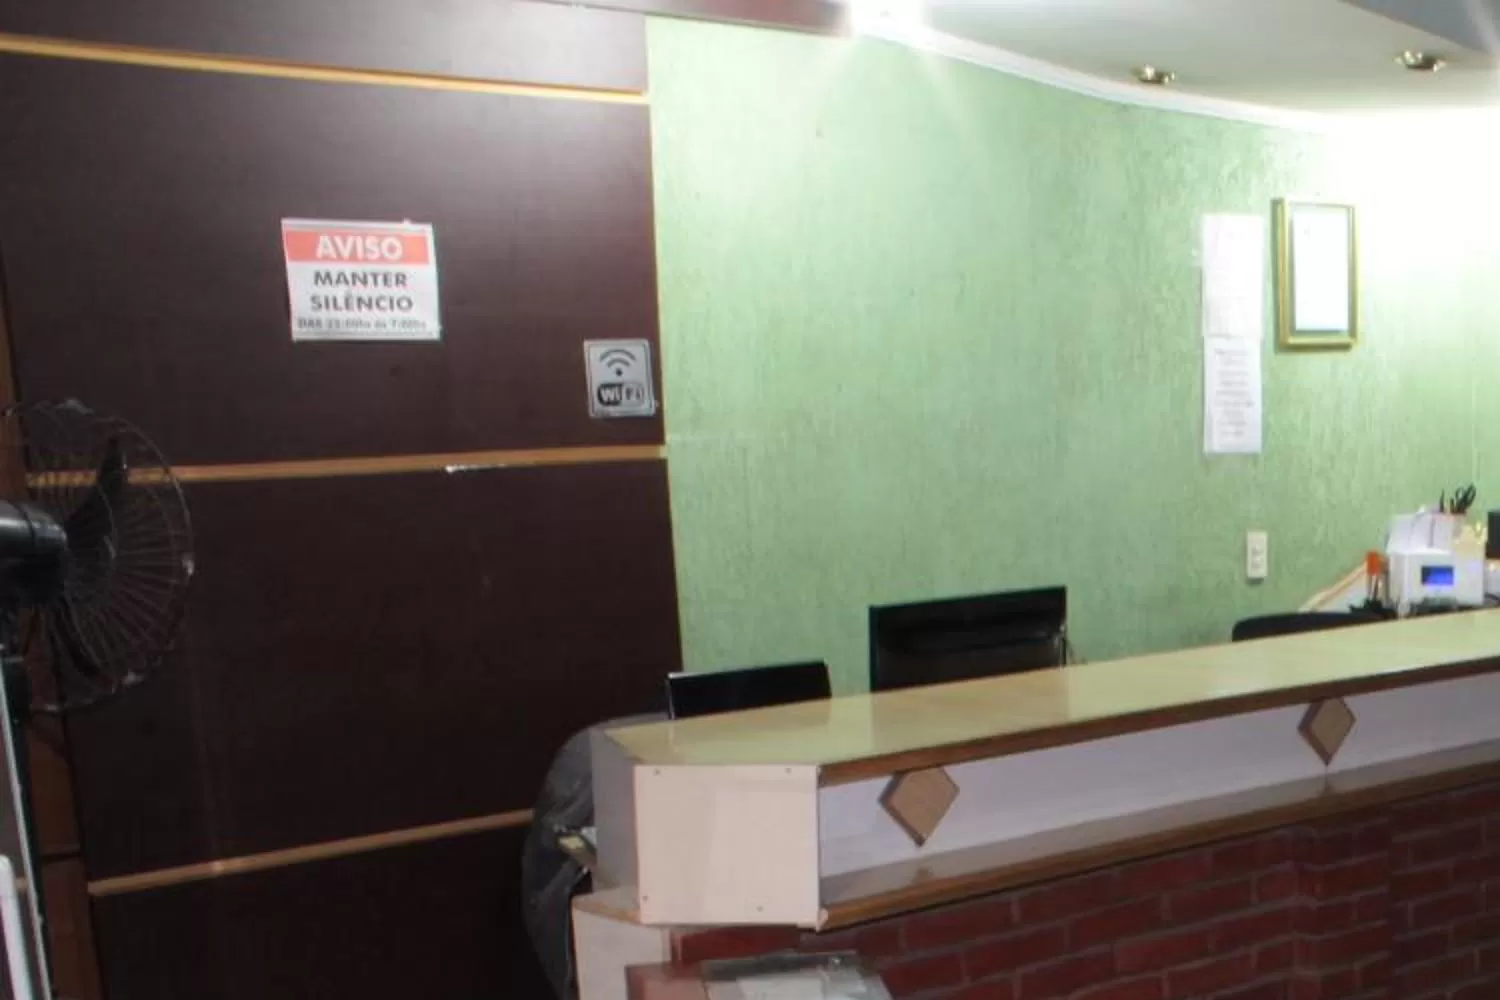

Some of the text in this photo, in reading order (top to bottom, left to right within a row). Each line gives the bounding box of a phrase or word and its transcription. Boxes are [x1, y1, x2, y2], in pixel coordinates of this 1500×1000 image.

[316, 235, 403, 260] AVISO
[313, 270, 408, 288] MANTER
[309, 291, 414, 313] SILÊNCIO
